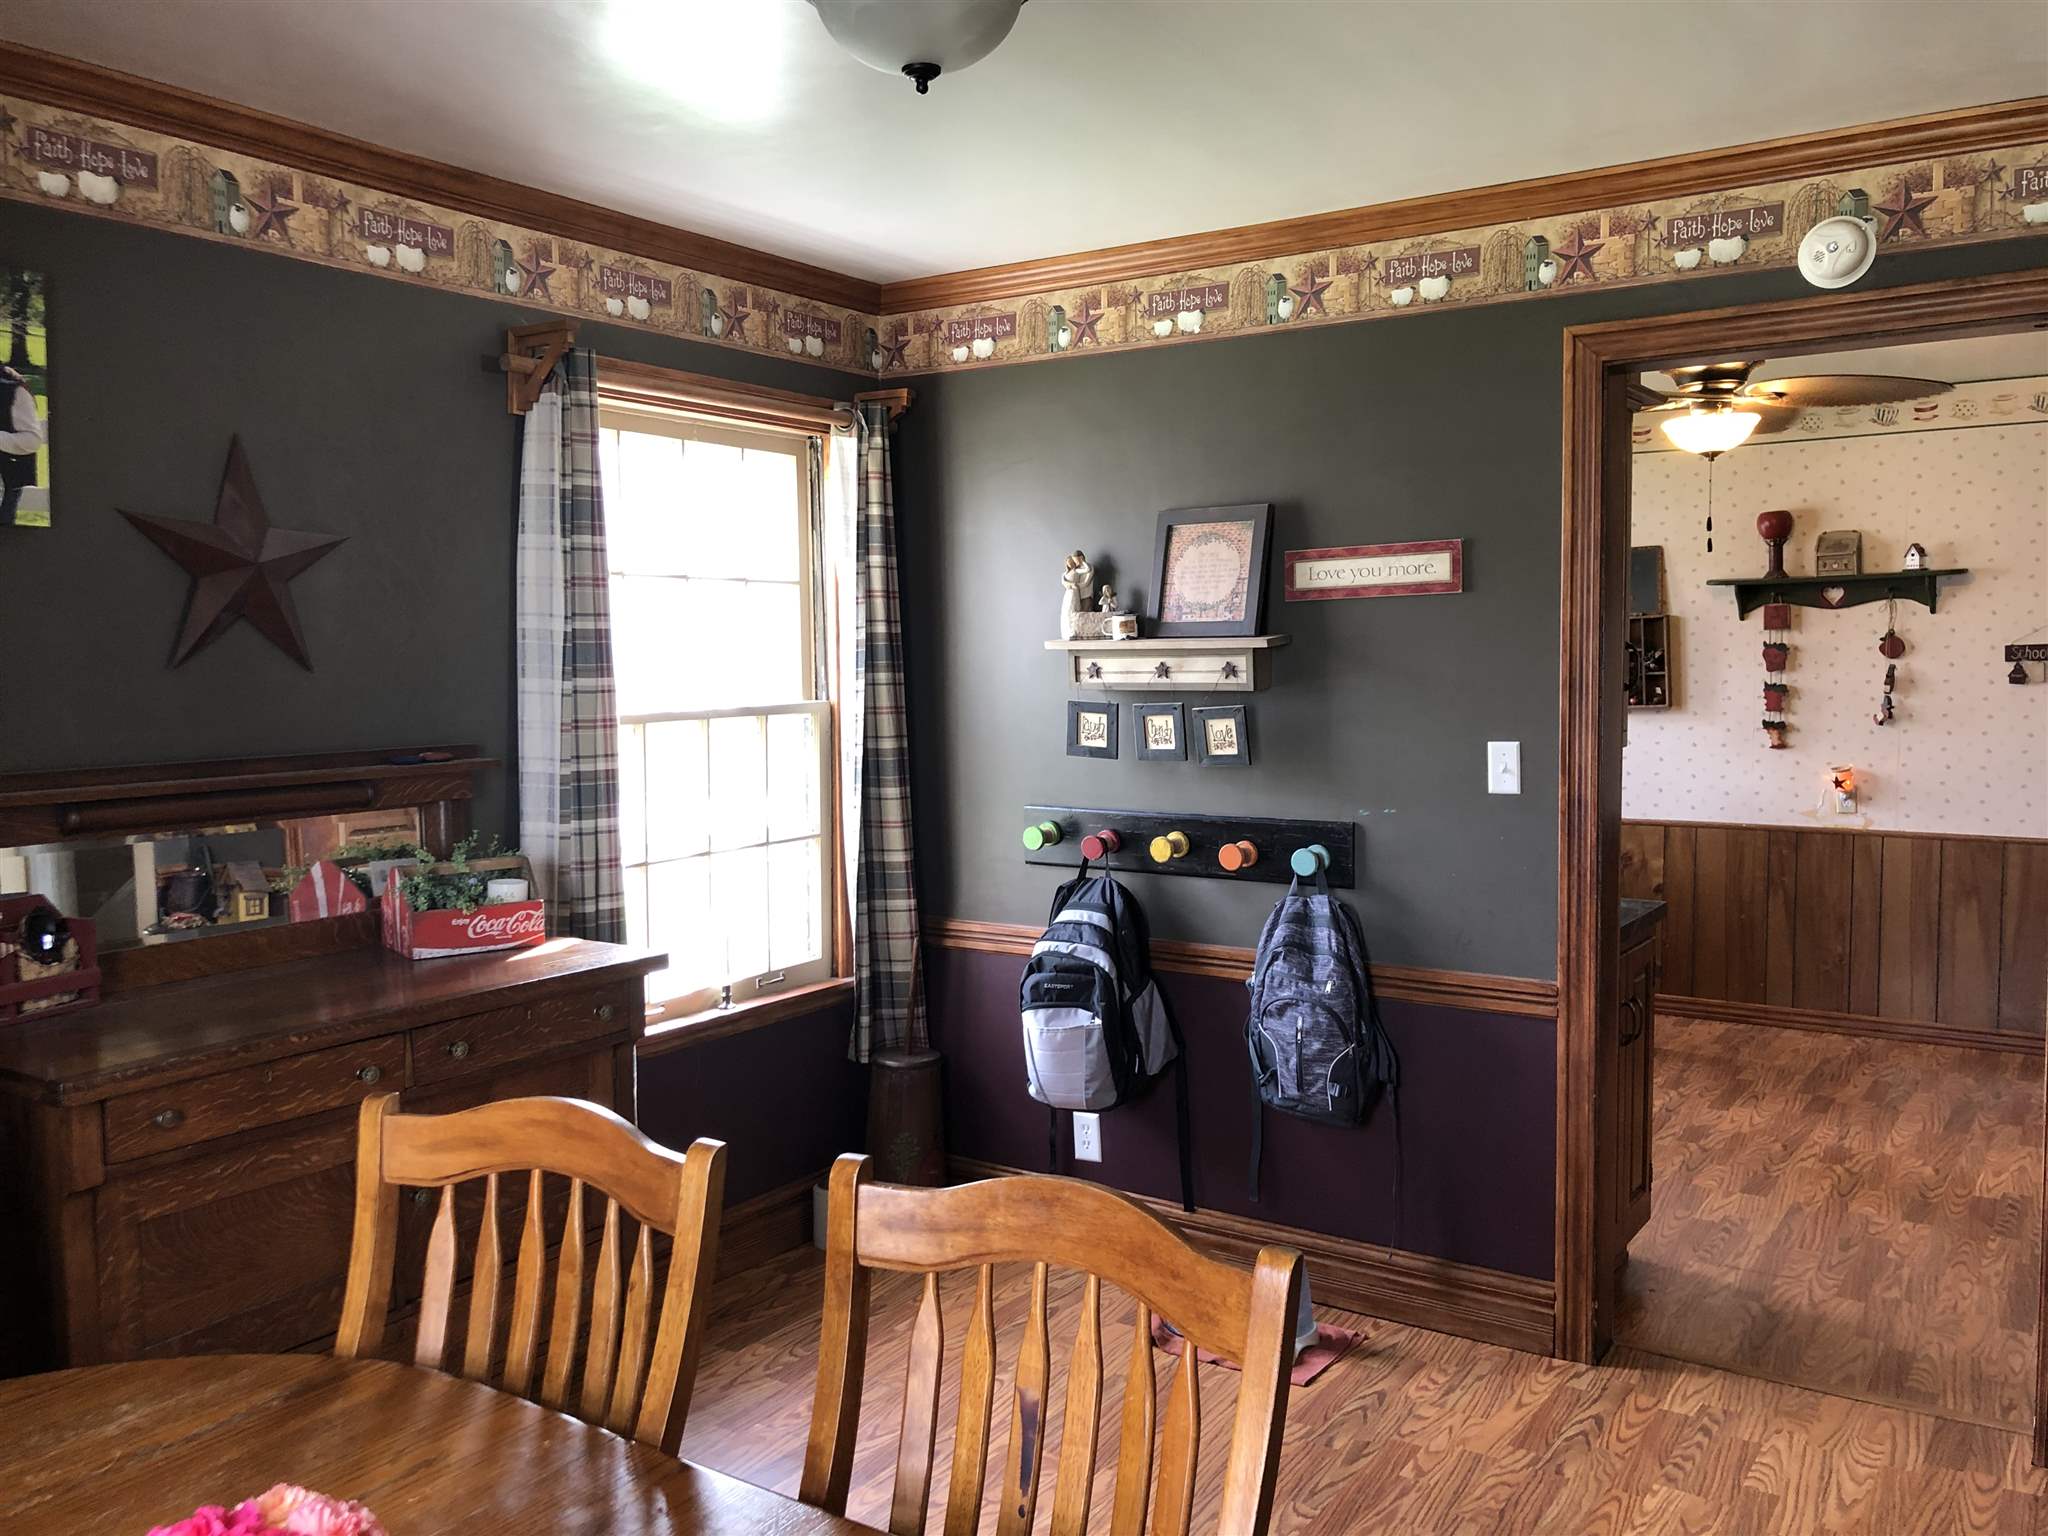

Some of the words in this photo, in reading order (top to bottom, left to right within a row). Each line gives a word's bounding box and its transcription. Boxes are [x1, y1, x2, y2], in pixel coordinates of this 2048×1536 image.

[79, 141, 114, 172] Hope
[397, 219, 423, 246] Hope
[1712, 213, 1743, 237] Hope
[1422, 255, 1448, 277] Hope
[628, 273, 648, 297] Hope
[1179, 288, 1201, 310] Hope
[974, 319, 993, 339] Hope
[1308, 566, 1346, 582] Love
[1349, 566, 1382, 584] you
[1388, 562, 1437, 577] more.
[1210, 724, 1233, 742] Love
[467, 909, 544, 938] Coca-Cola
